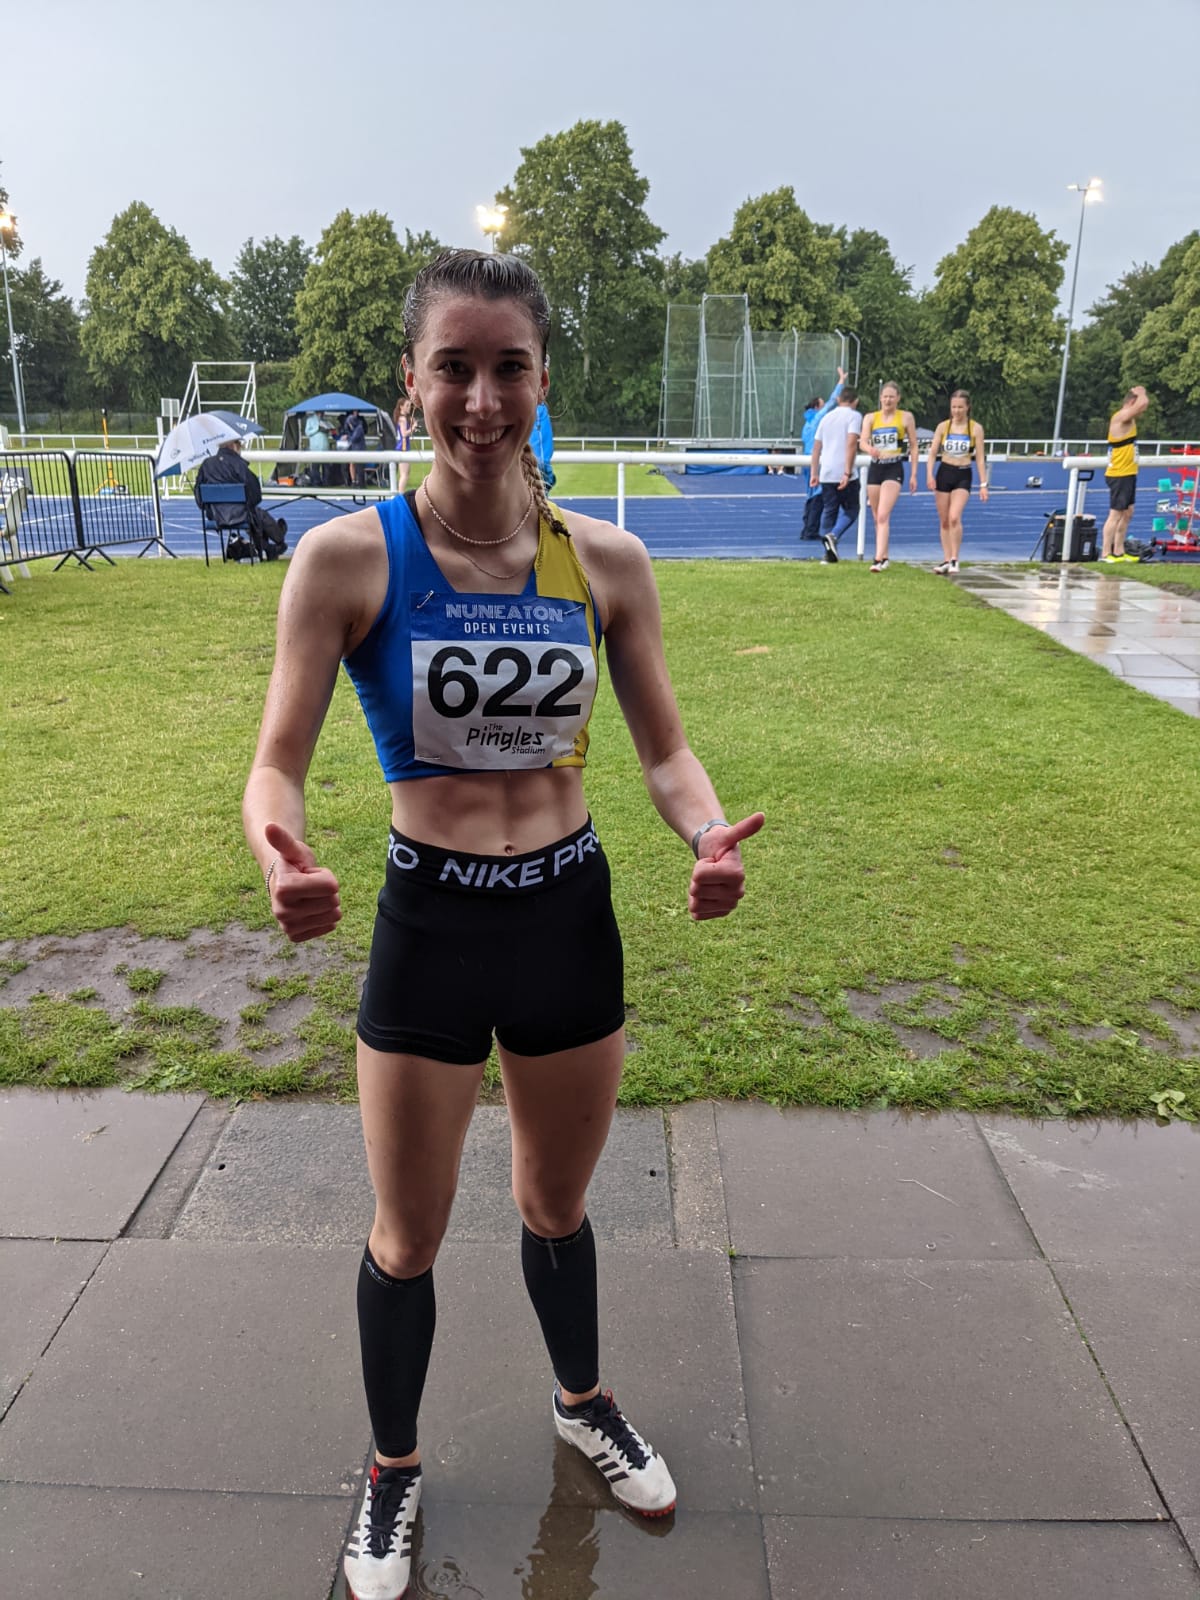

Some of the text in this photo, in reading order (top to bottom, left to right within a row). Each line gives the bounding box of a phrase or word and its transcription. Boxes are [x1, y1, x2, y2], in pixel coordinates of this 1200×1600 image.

[873, 434, 896, 445] 615
[945, 441, 968, 451] 616
[446, 603, 564, 622] NUNEATON
[464, 622, 550, 635] OPEN EVENTS
[427, 646, 584, 718] 622
[466, 725, 544, 752] Pingles
[511, 745, 545, 755] Stadium
[439, 857, 545, 888] NIKE
